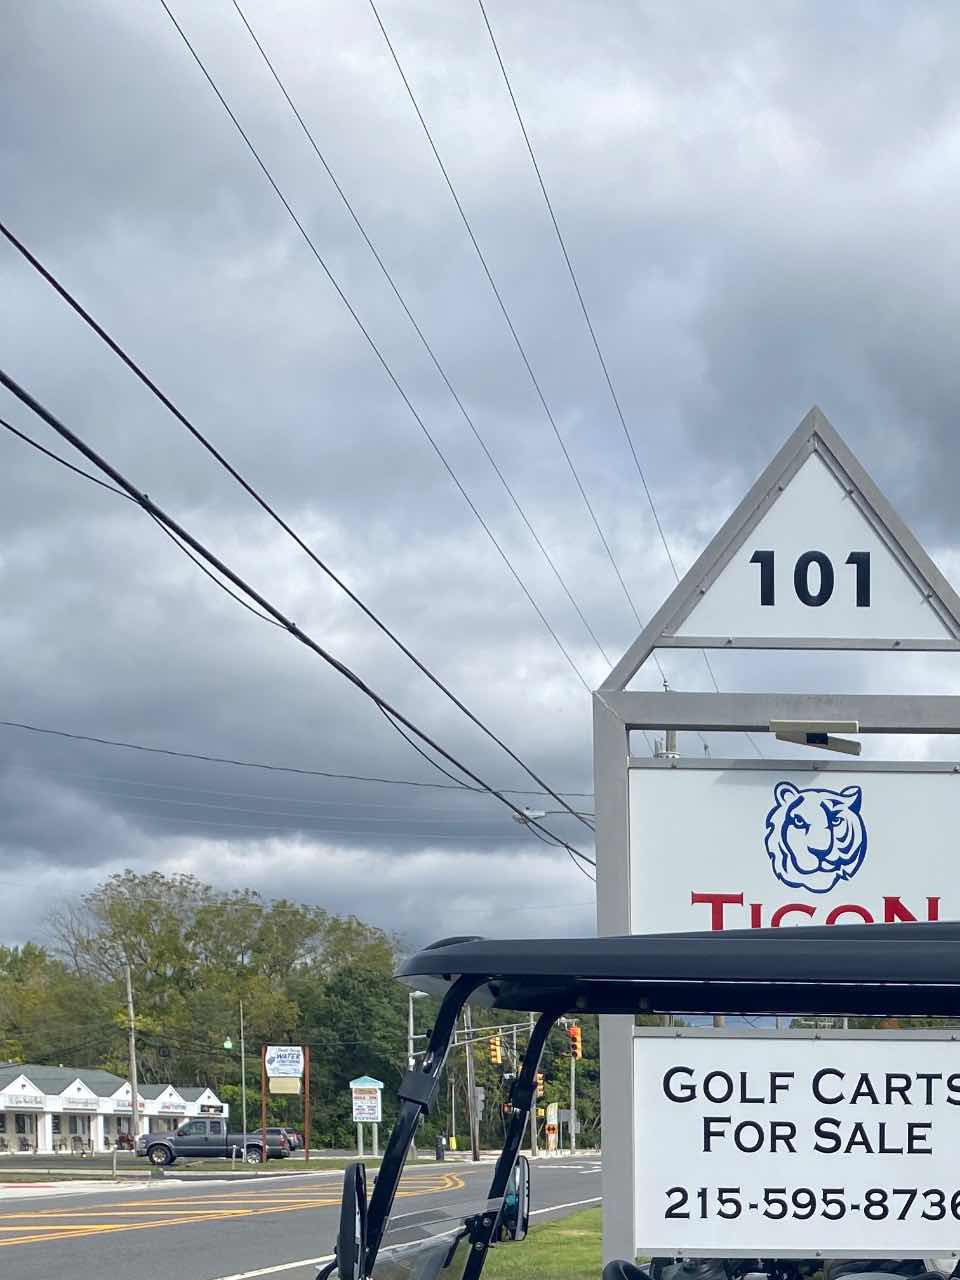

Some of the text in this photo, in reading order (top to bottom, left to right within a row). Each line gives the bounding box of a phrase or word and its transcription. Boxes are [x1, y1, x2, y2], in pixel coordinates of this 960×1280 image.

[749, 550, 871, 608] 101
[662, 1066, 795, 1105] GOLF
[702, 1116, 933, 1155] FOR SALE
